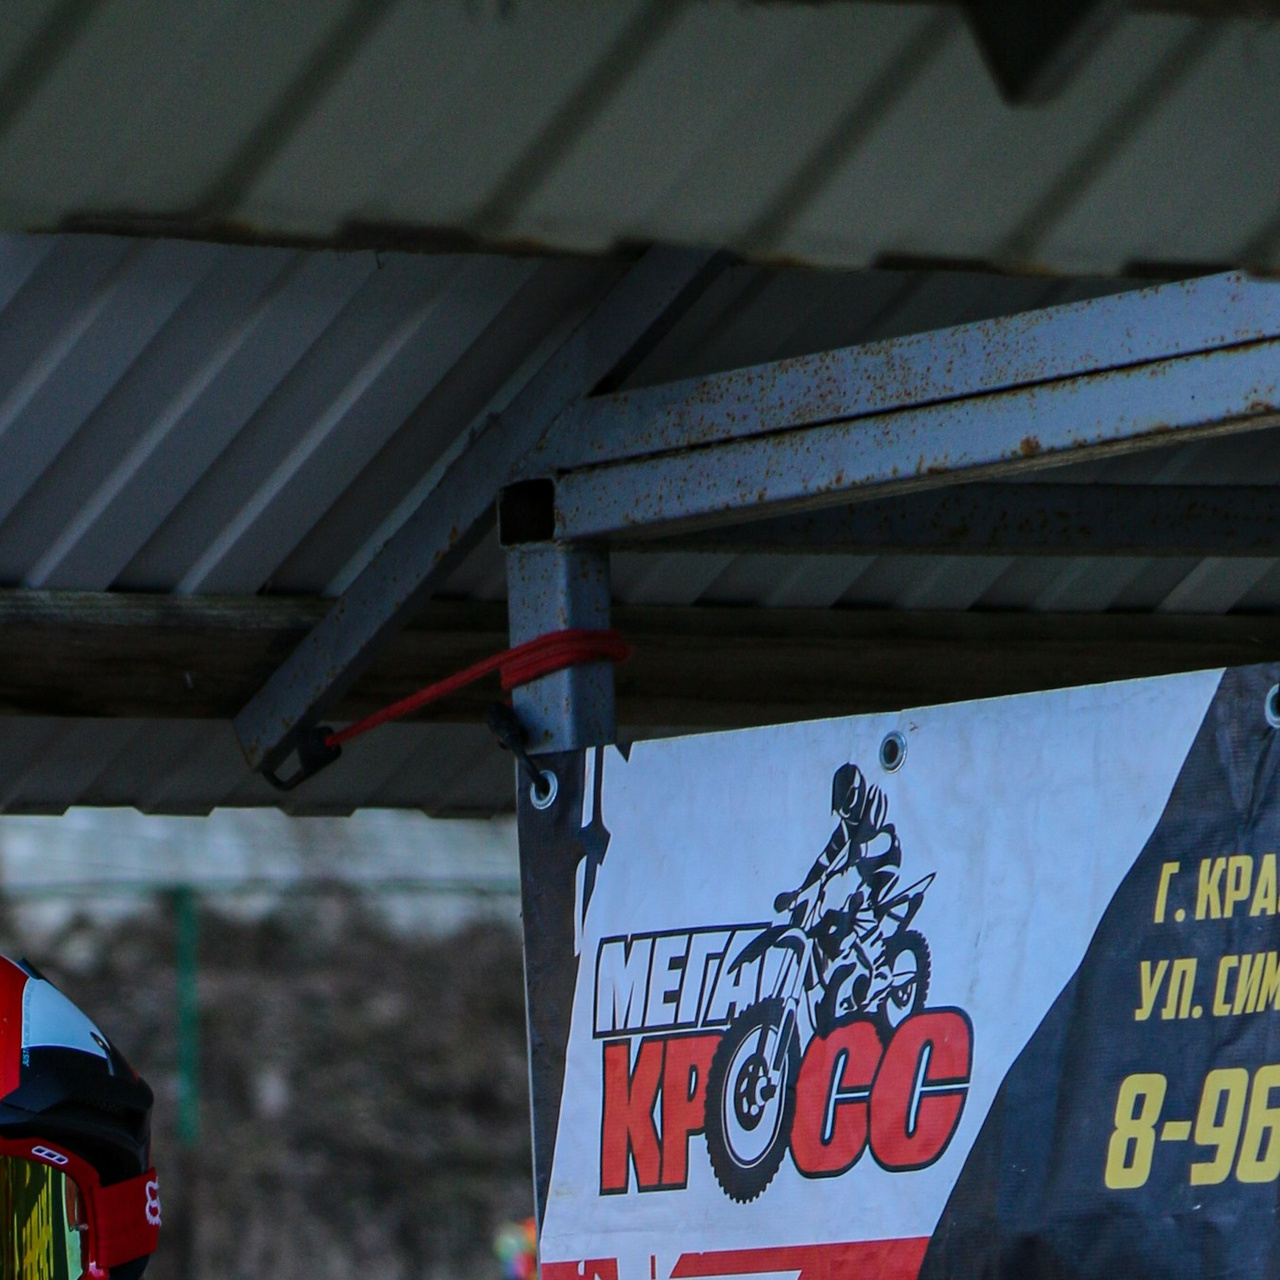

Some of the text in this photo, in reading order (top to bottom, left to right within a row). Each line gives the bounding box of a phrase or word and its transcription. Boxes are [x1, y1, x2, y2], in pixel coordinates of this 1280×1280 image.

[1154, 853, 1280, 923] Г. КРА
[593, 922, 772, 1039] МЕГА
[1135, 958, 1203, 1021] УЛ.
[599, 1005, 973, 1204] КРОСС
[1105, 1064, 1280, 1189] 8-96
